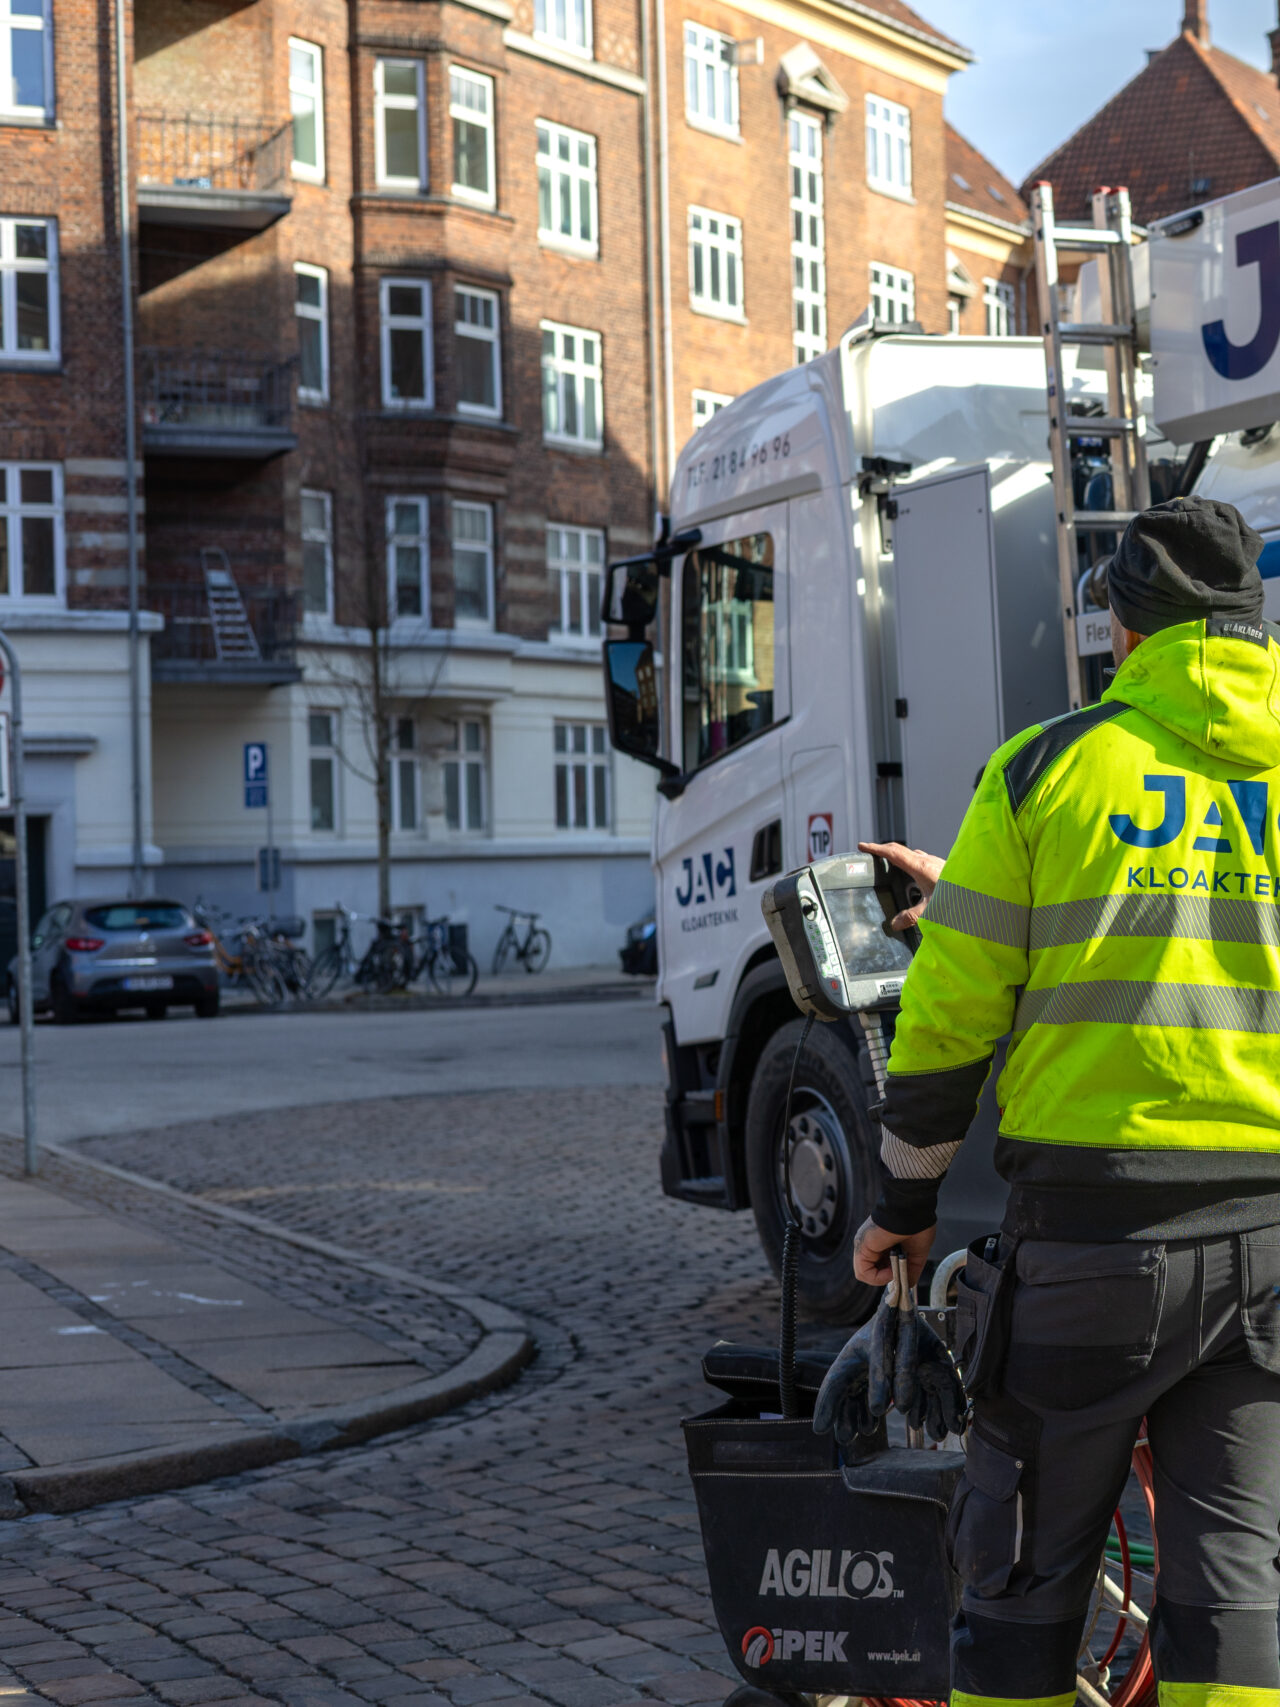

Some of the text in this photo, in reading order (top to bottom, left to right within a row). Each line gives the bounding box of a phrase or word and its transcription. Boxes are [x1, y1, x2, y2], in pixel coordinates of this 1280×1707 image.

[711, 456, 726, 480] 21
[773, 432, 790, 461] 96
[248, 746, 263, 779] P
[810, 830, 831, 854] TIP
[676, 846, 737, 907] JAC
[681, 908, 739, 932] KLOAKTEKNIK
